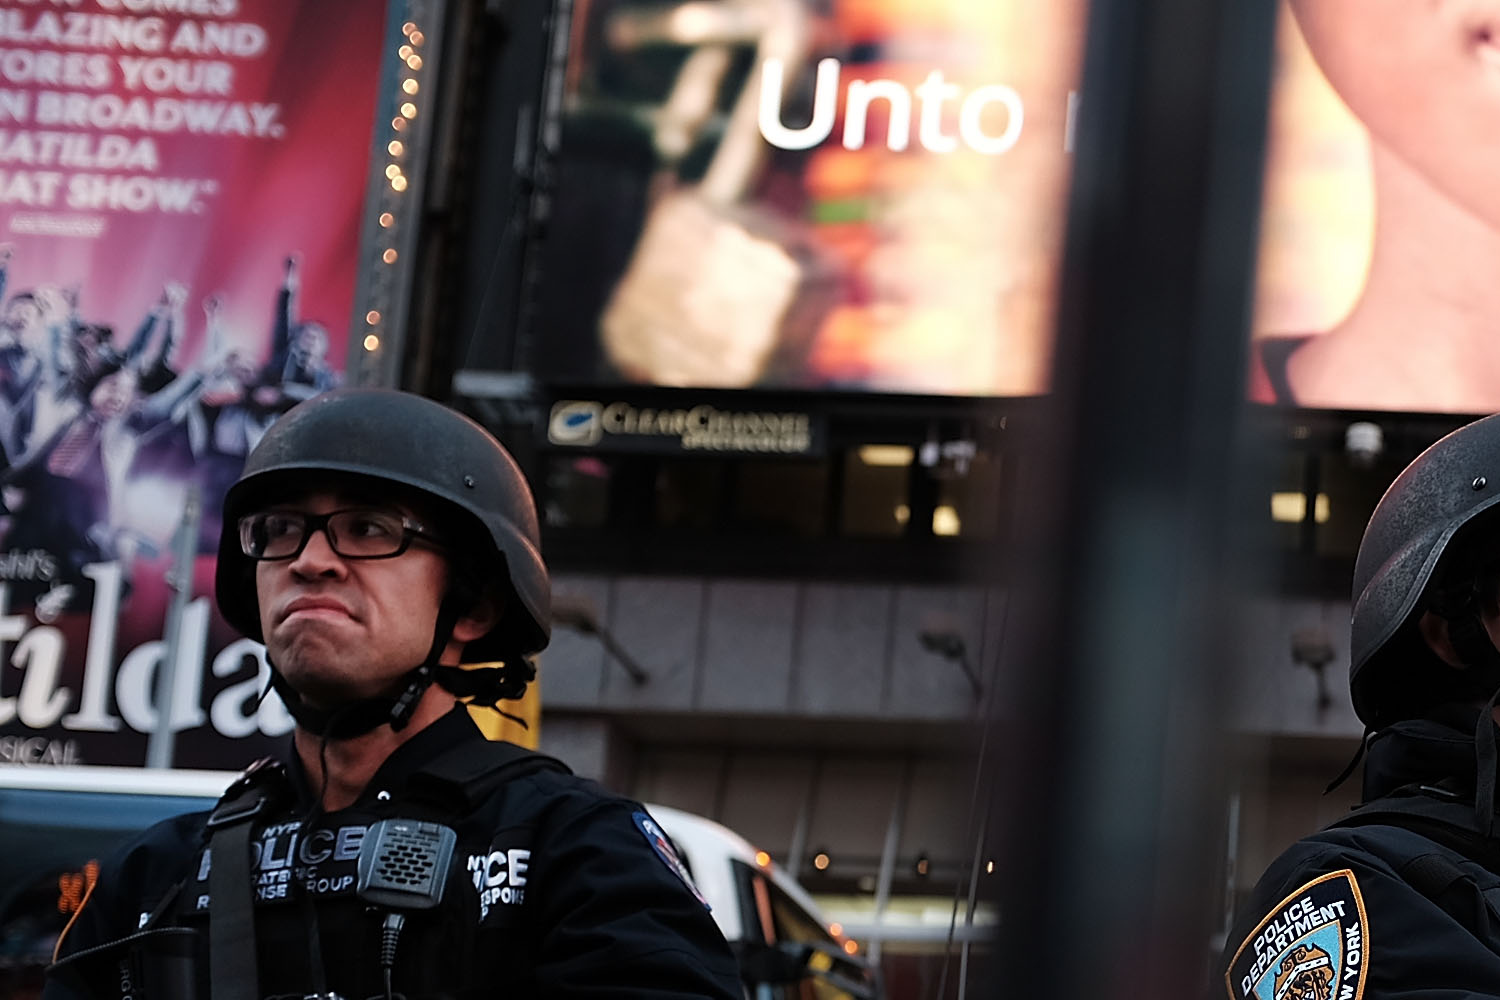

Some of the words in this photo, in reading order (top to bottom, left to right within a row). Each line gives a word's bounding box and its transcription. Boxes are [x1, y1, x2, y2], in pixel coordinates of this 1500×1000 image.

[0, 8, 166, 52] LAZING
[170, 20, 268, 57] AND
[0, 48, 114, 89] ORES
[118, 55, 235, 96] YOUR
[36, 92, 286, 138] BROADWAY.
[757, 57, 1025, 155] Unto
[0, 128, 160, 172] ATILDA
[0, 168, 63, 207] AT
[1240, 900, 1346, 998] DEPARTMENT
[1253, 895, 1315, 957] POLICE
[1344, 921, 1361, 982] YORK
